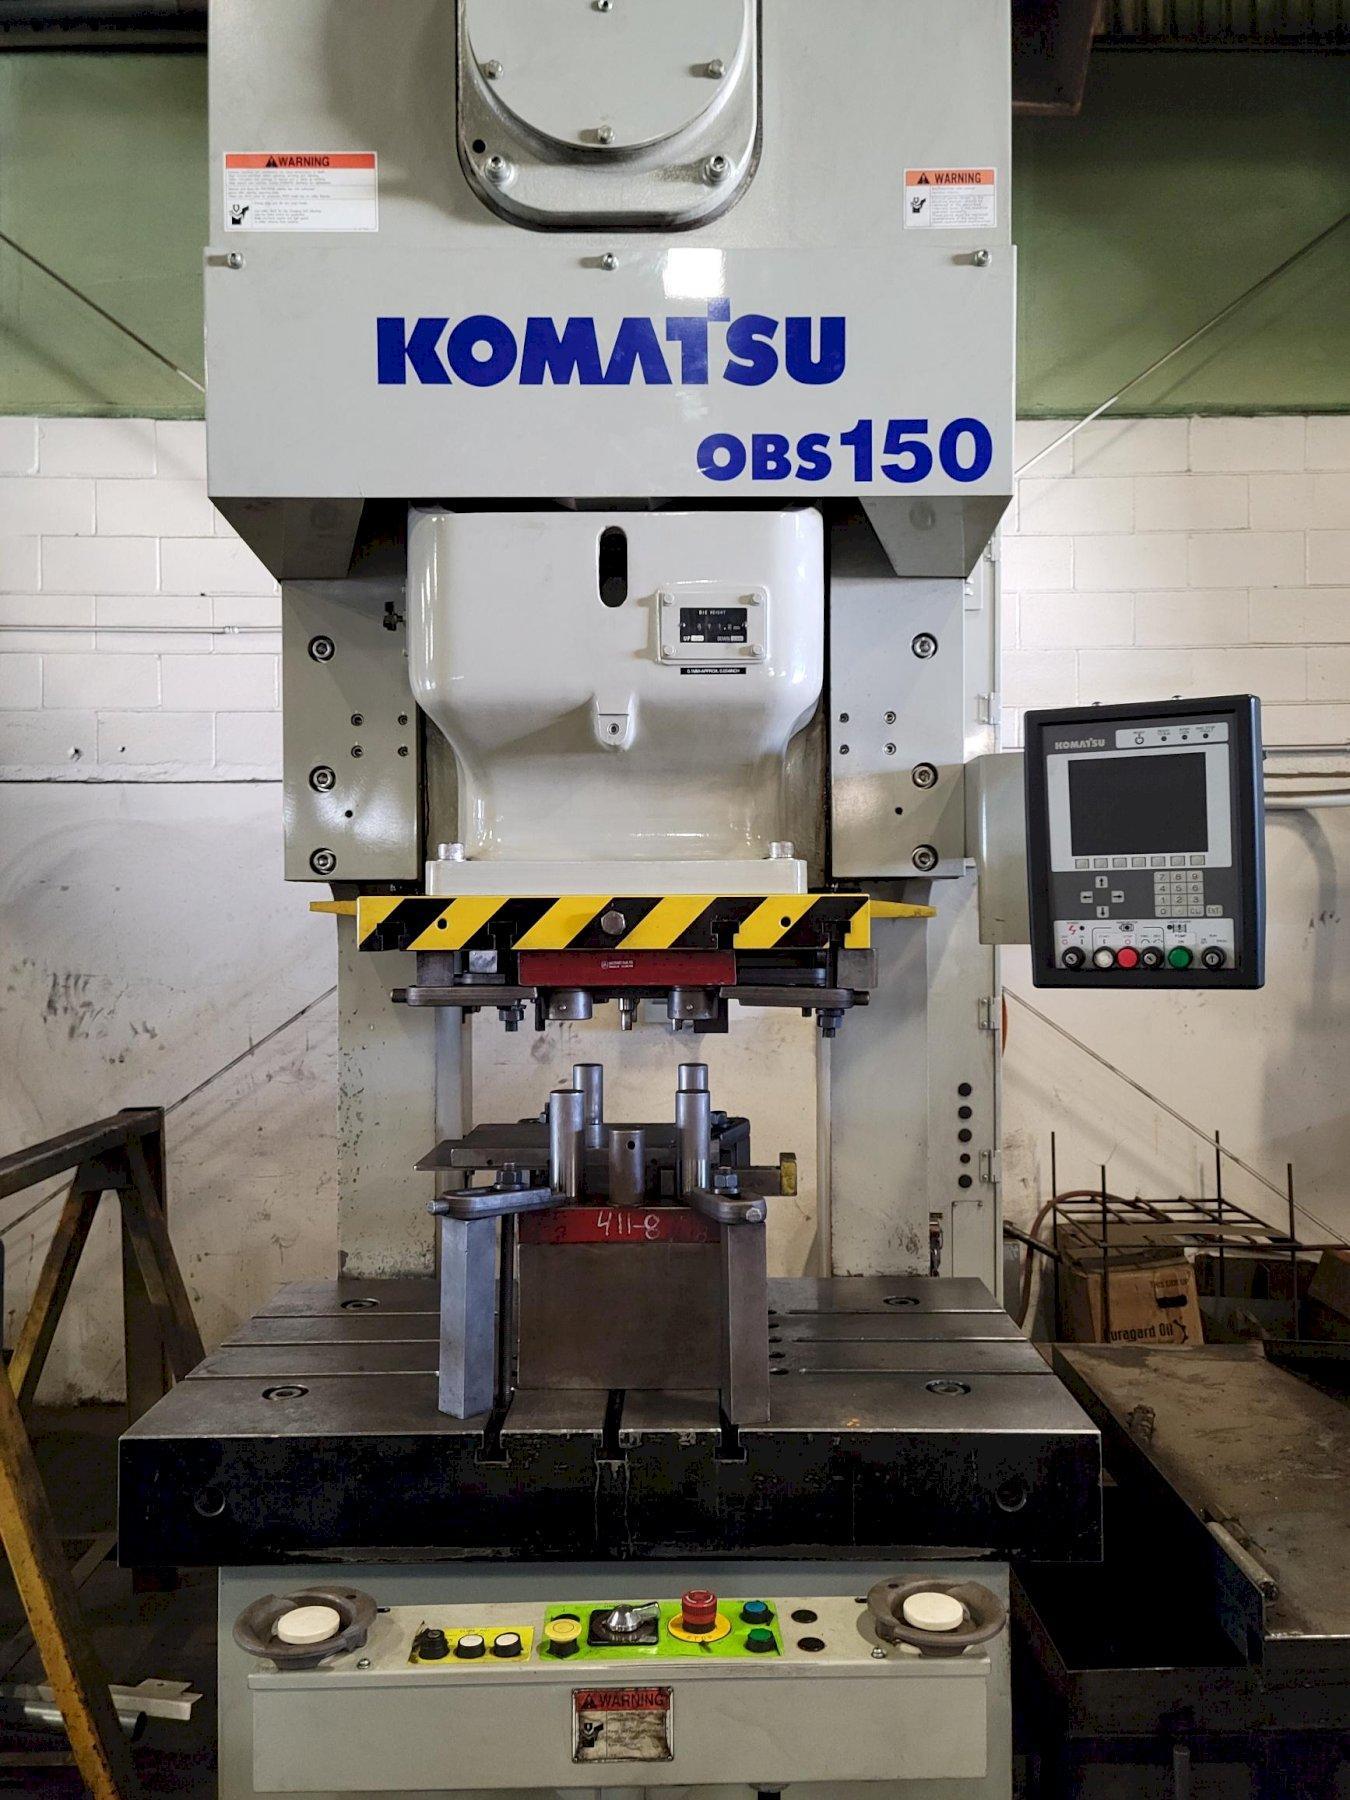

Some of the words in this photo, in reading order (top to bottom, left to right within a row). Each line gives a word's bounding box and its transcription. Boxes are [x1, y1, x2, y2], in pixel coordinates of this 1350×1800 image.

[278, 156, 330, 168] WARNING
[934, 172, 982, 184] WARNING
[376, 297, 846, 387] KOMATSU
[1054, 738, 1106, 750] KOMATSU
[596, 1210, 661, 1240] 411-8
[1159, 1322, 1173, 1337] Oil
[599, 1693, 664, 1707] WARNING
